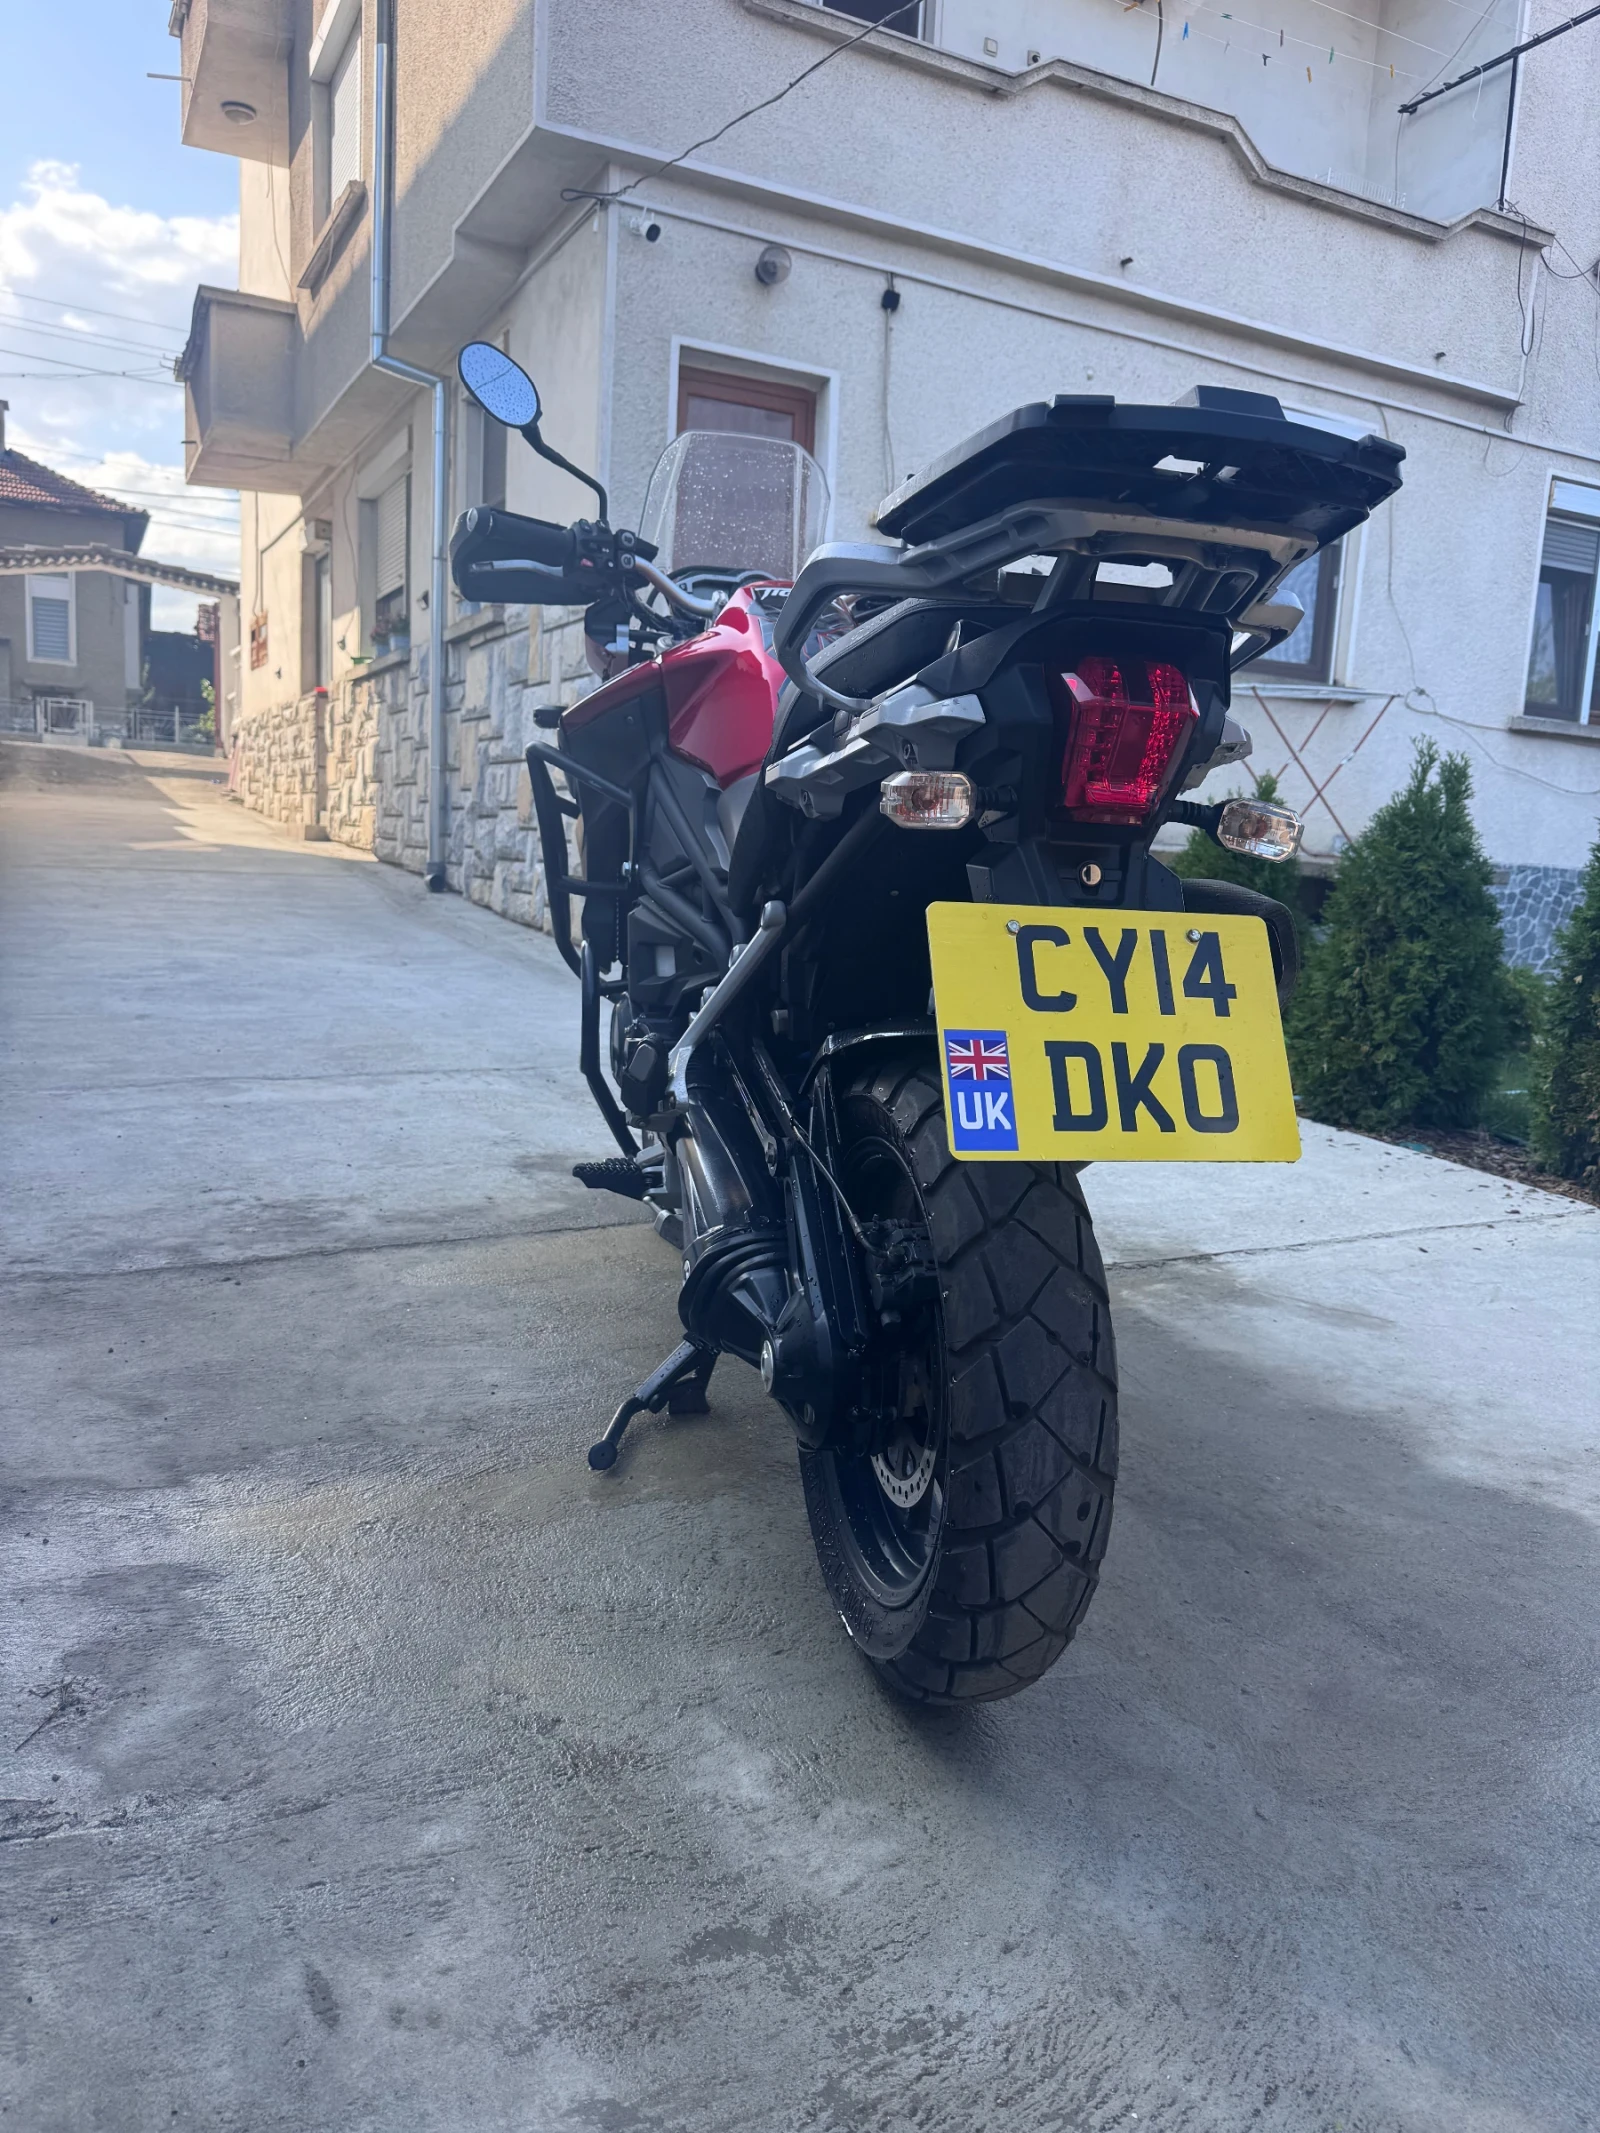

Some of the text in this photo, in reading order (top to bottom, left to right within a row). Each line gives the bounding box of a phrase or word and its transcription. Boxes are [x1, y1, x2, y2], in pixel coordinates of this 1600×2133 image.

[1016, 924, 1238, 1018] CY14
[957, 1091, 1013, 1131] UK
[1043, 1040, 1240, 1134] DKO
